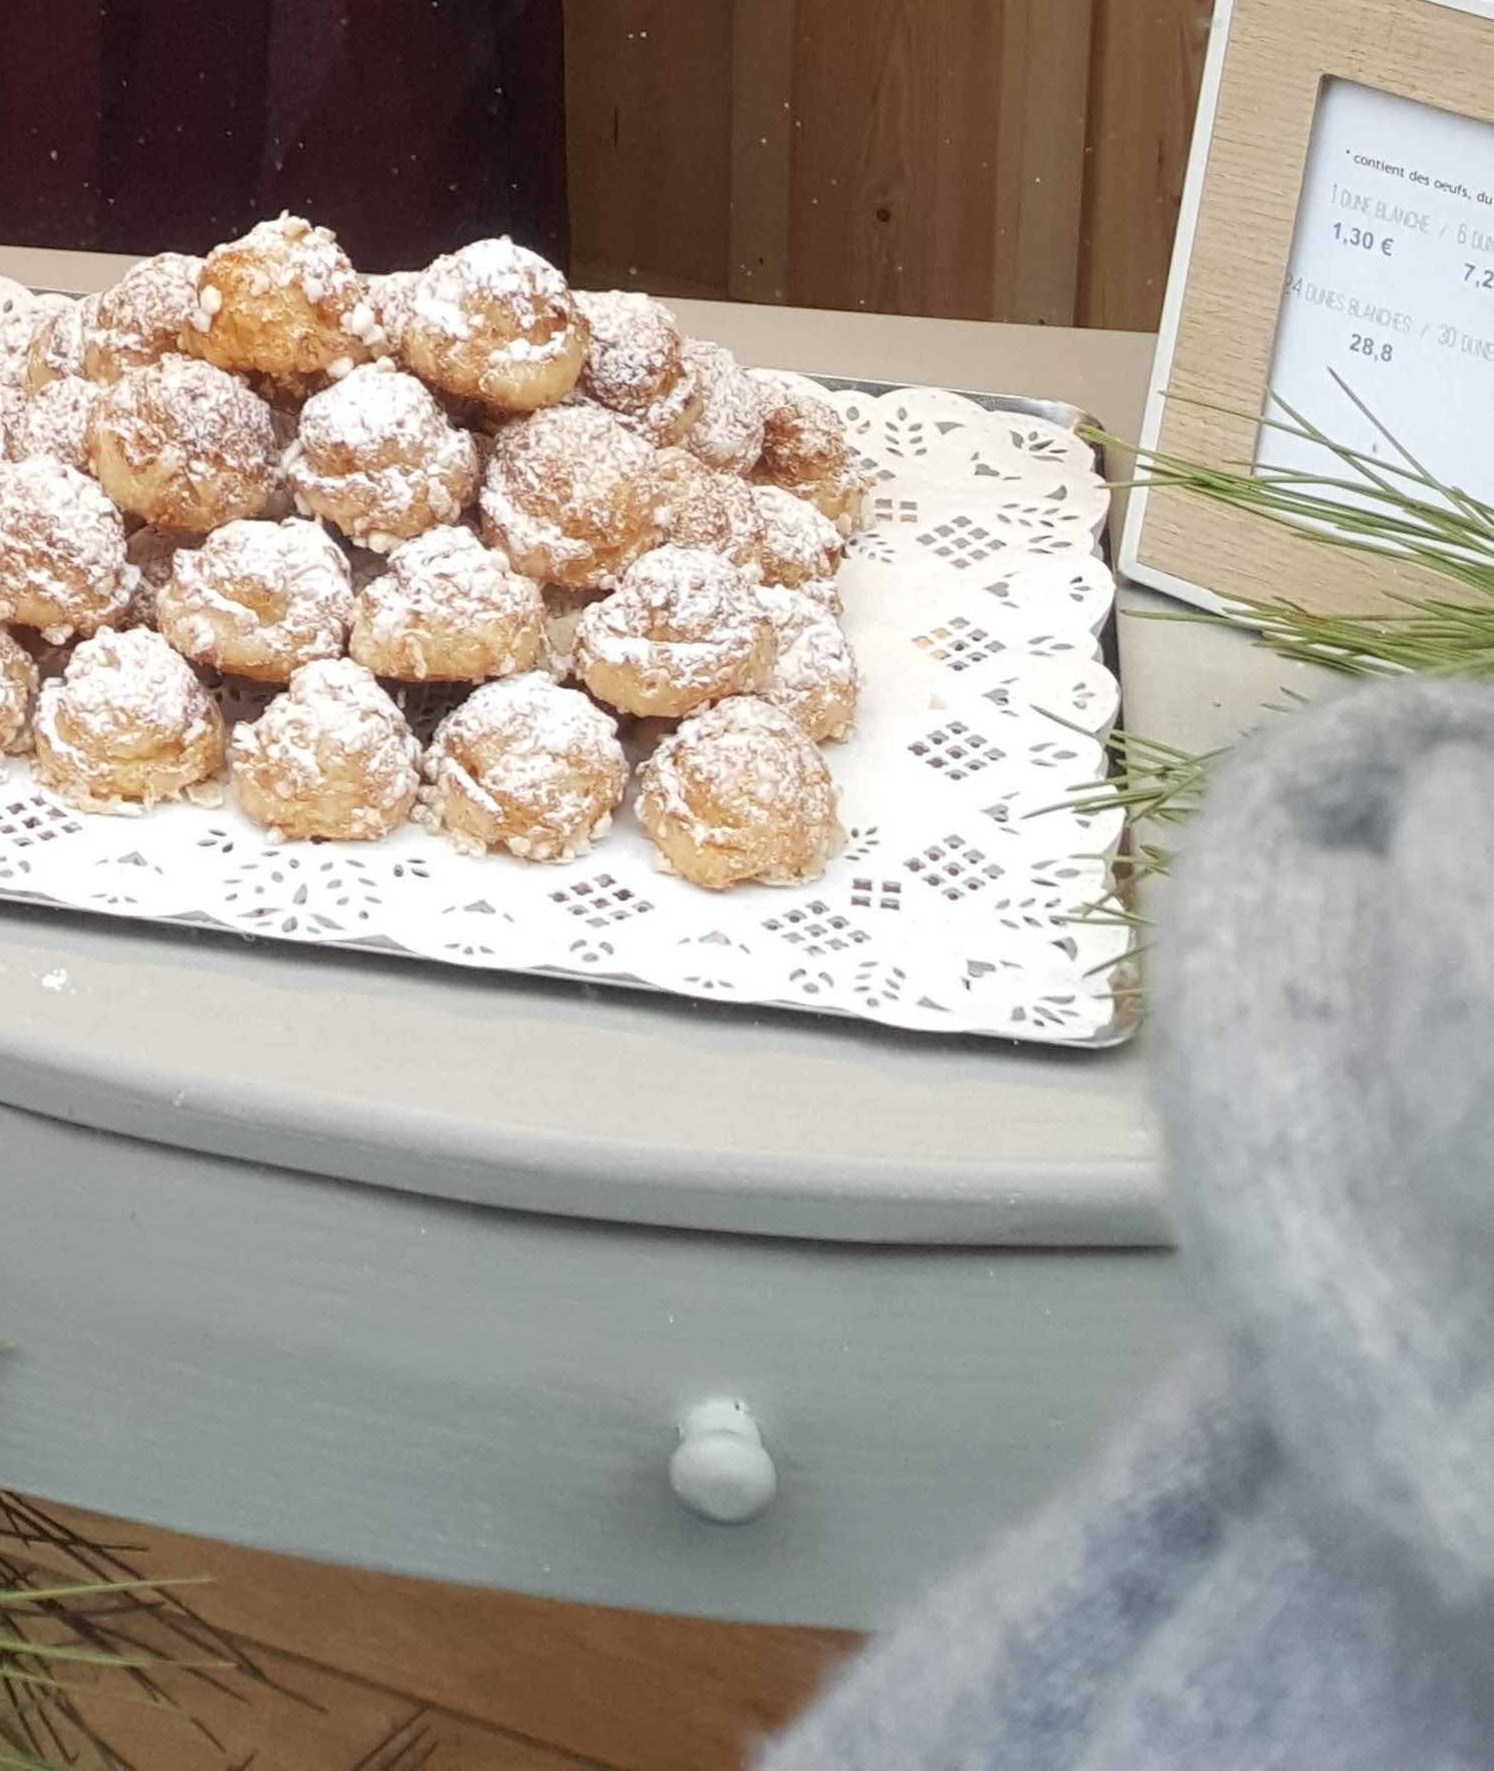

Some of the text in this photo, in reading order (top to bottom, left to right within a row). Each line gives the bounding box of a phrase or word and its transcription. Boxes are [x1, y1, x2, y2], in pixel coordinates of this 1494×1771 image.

[1353, 153, 1493, 206] contient des oeufs, du
[1332, 222, 1395, 257] 1,30 €
[1340, 188, 1372, 216] DUNE
[1374, 200, 1432, 235] BLANCHE
[1457, 223, 1468, 245] 6
[1305, 282, 1346, 313] DUNES
[1348, 296, 1413, 334] BLANCHES
[1437, 322, 1457, 349] 30
[1348, 332, 1394, 363] 28,8
